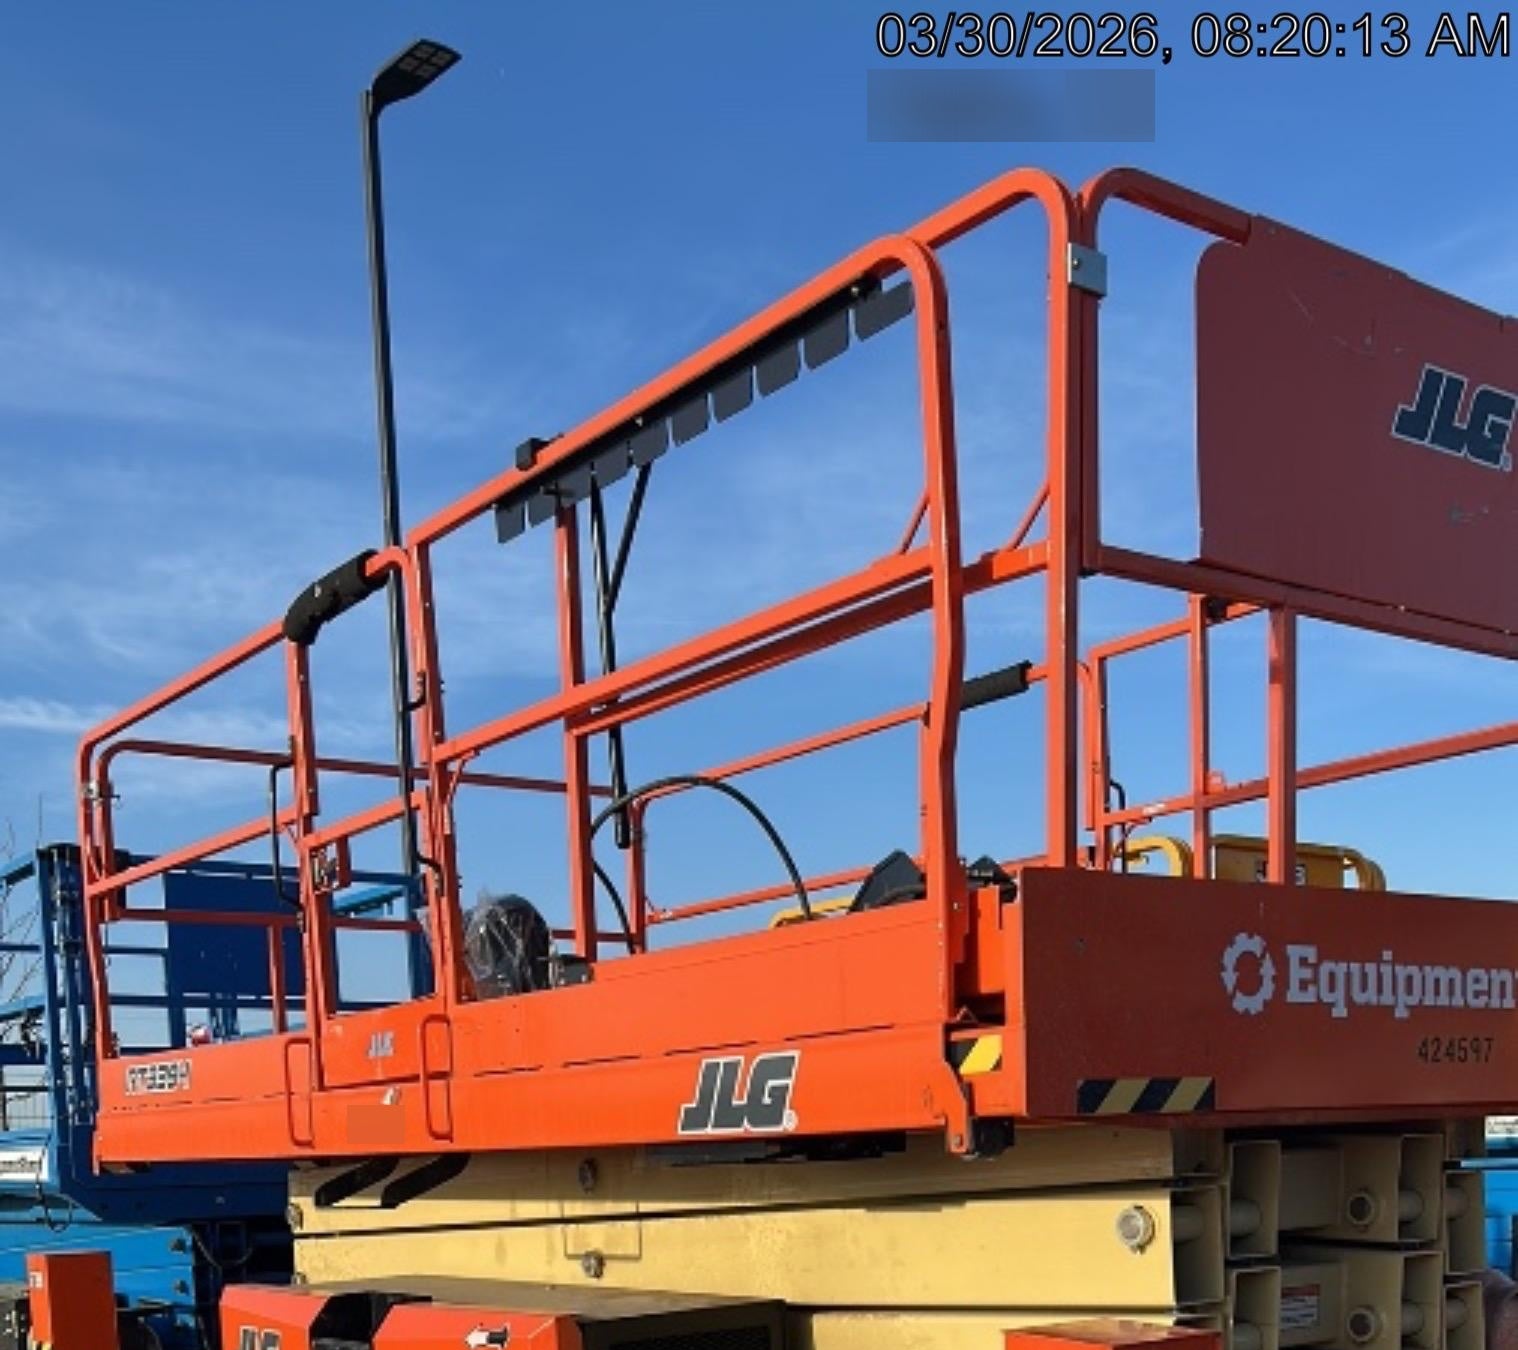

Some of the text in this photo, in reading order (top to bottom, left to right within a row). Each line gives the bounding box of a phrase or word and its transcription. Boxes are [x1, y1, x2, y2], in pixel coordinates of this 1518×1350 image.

[1391, 363, 1518, 472] JLG
[1286, 944, 1518, 1019] Equipmen
[1418, 1037, 1495, 1064] 424597
[678, 1049, 801, 1135] JLG
